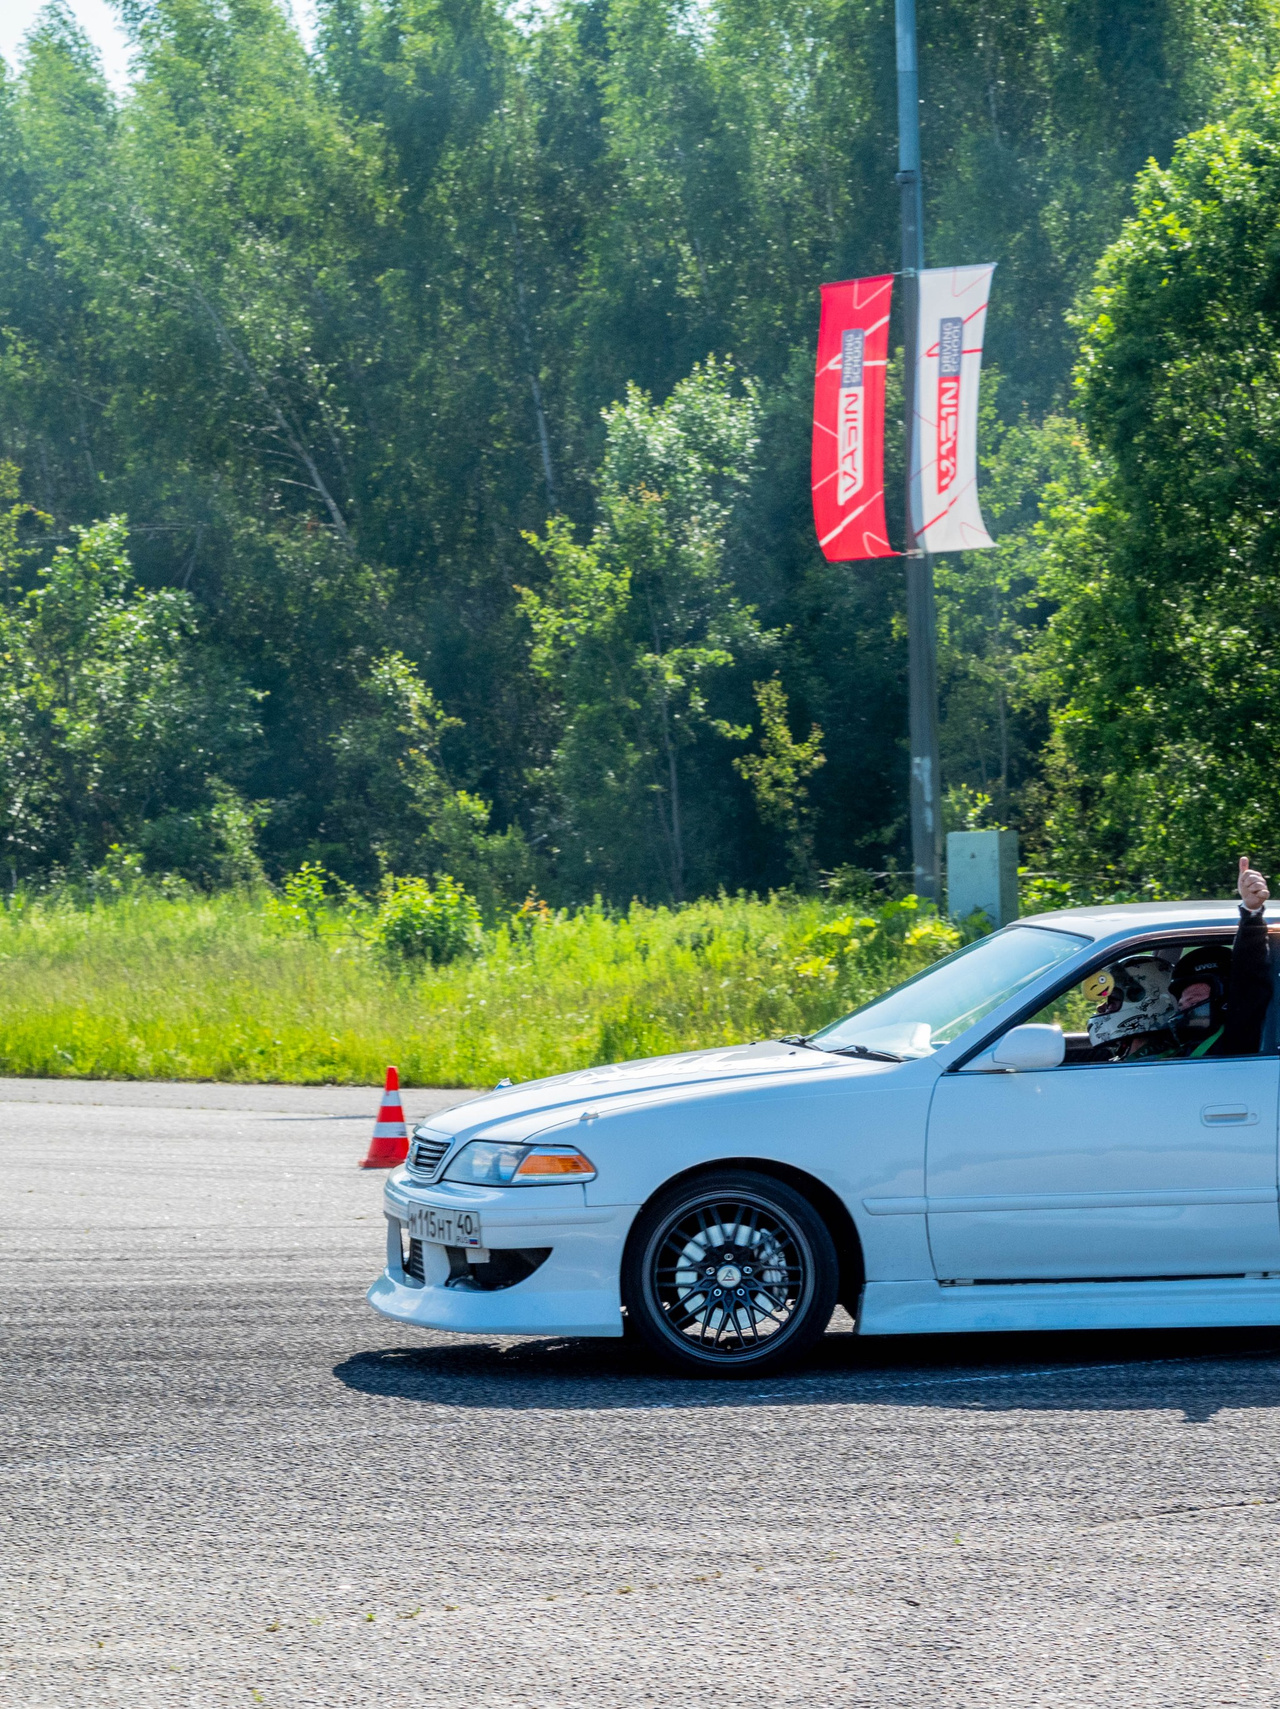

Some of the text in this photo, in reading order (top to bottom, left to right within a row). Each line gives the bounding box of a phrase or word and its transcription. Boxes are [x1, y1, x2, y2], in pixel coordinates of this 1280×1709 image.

[842, 334, 854, 384] DRIVING
[851, 334, 863, 383] SCHOOL
[942, 322, 953, 373] DRIVING
[950, 324, 962, 372] SCHOOL
[842, 393, 859, 494] VASIN
[1194, 962, 1219, 971] uvex
[457, 1213, 473, 1235] 40
